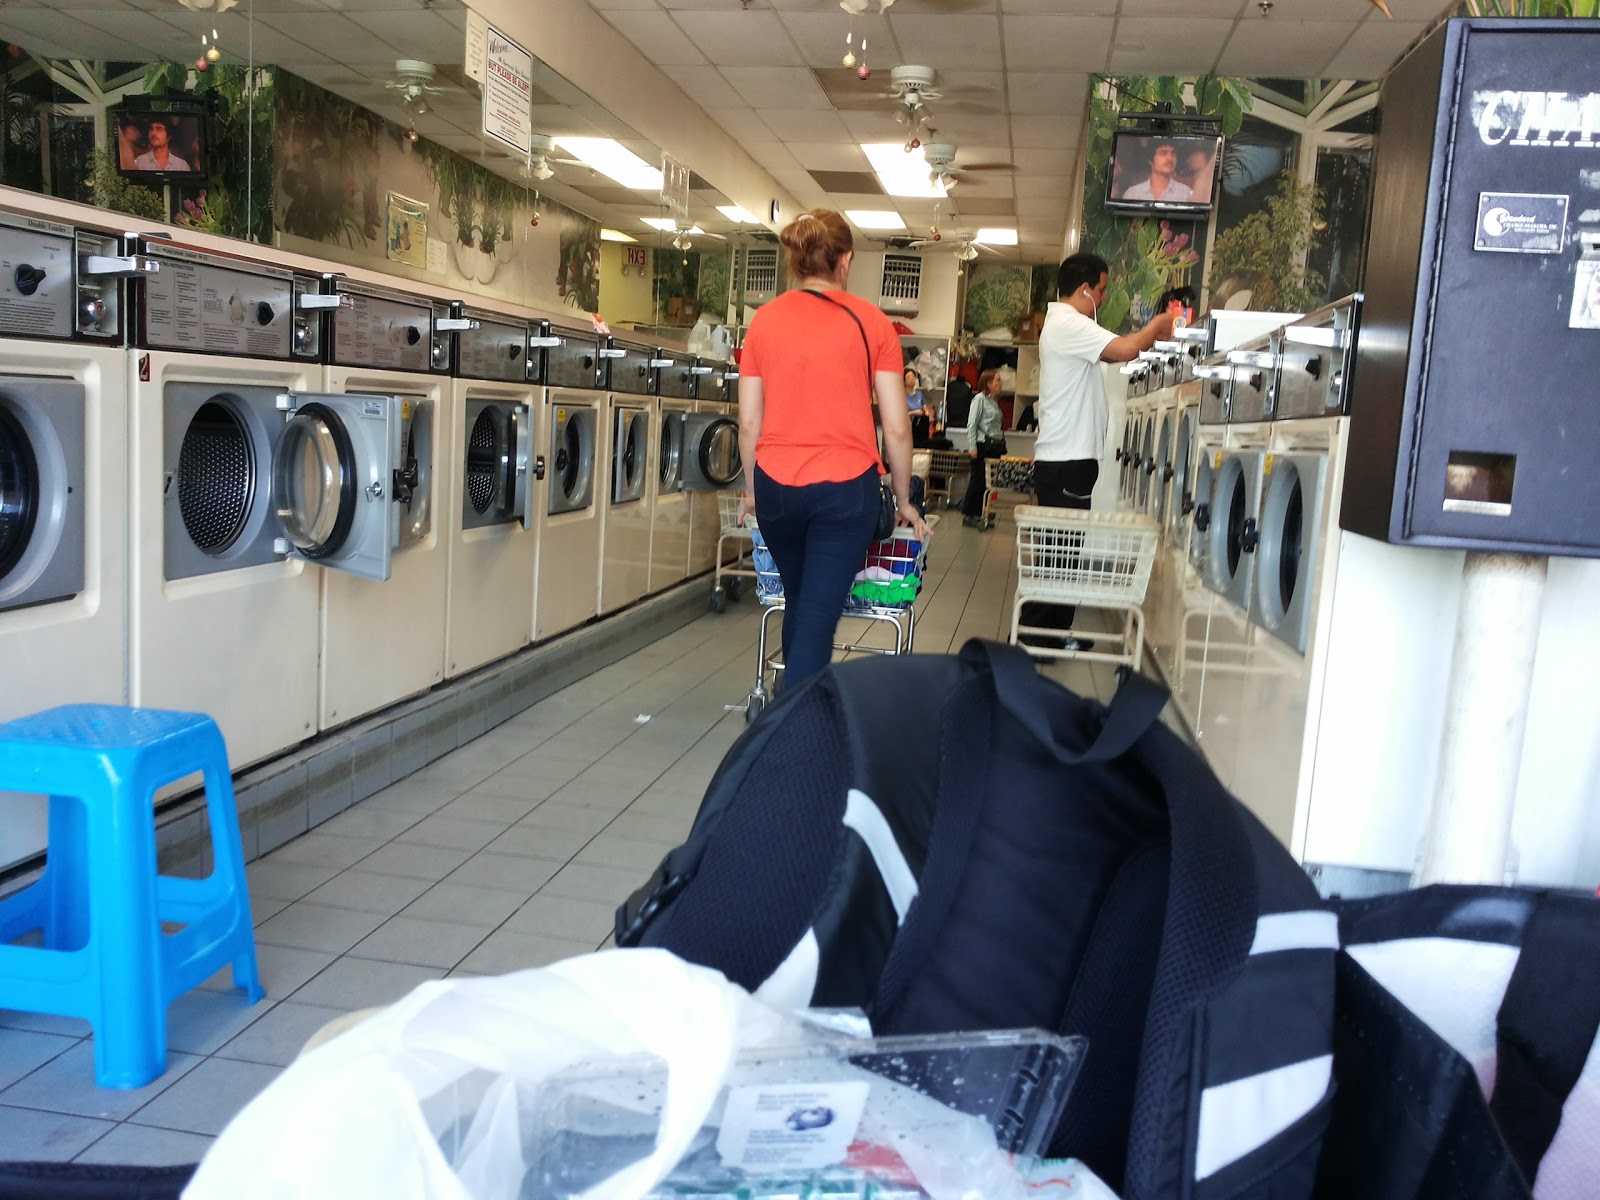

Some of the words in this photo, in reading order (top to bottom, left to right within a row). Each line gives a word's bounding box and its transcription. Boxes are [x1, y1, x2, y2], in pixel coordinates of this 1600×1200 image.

[497, 65, 511, 82] PLEASE
[1479, 91, 1600, 147] CHA
[1499, 212, 1536, 224] Standard
[28, 219, 46, 229] Double
[48, 224, 66, 233] Loader
